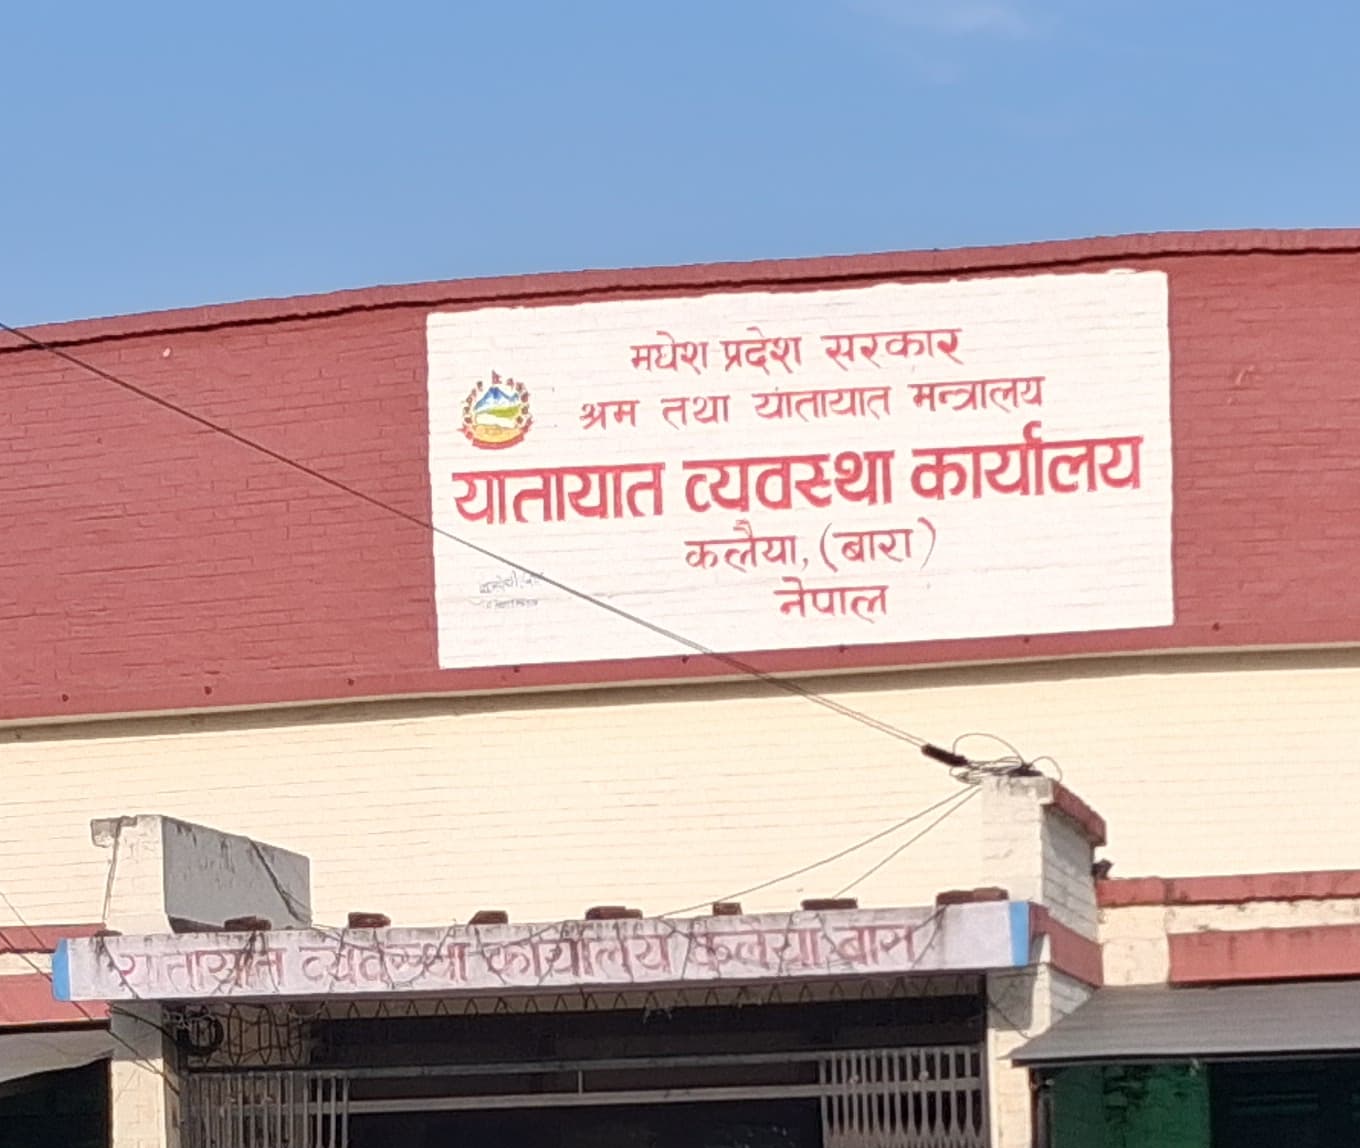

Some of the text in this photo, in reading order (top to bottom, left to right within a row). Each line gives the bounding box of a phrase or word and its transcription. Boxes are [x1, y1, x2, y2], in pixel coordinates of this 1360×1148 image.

[630, 327, 962, 376] मधेश प्रदेश सरकार
[579, 376, 1045, 430] श्रम तथा यातायात मन्त्रालय
[452, 420, 1145, 525] यातायात व्यवस्था कार्यालय
[684, 517, 938, 572] कलैया, (बारा)
[774, 577, 888, 622] नेपाल
